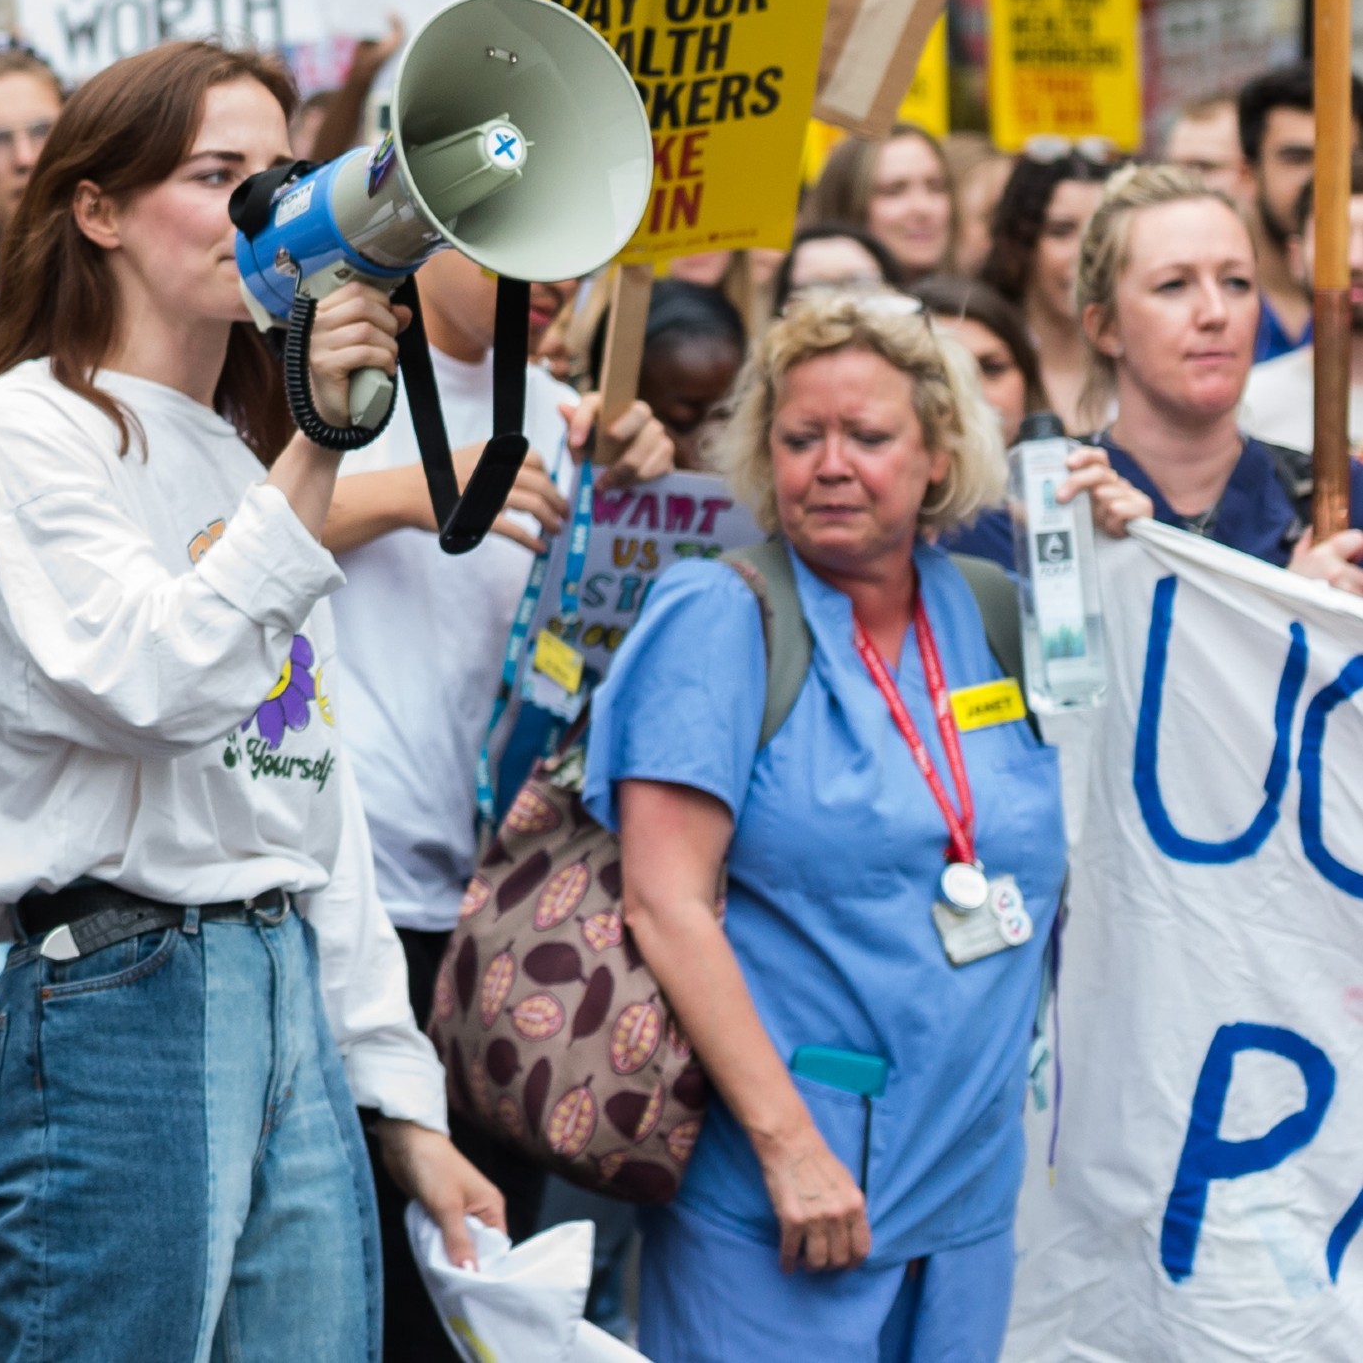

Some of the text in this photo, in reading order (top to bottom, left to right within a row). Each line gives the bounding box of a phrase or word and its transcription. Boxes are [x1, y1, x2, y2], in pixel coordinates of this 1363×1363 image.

[604, 22, 732, 78] ALTH
[637, 66, 784, 131] KERS
[648, 182, 705, 235] IN
[593, 490, 734, 534] WANT
[612, 537, 659, 571] US
[246, 737, 336, 793] Yourself
[1161, 1021, 1363, 1286] P
